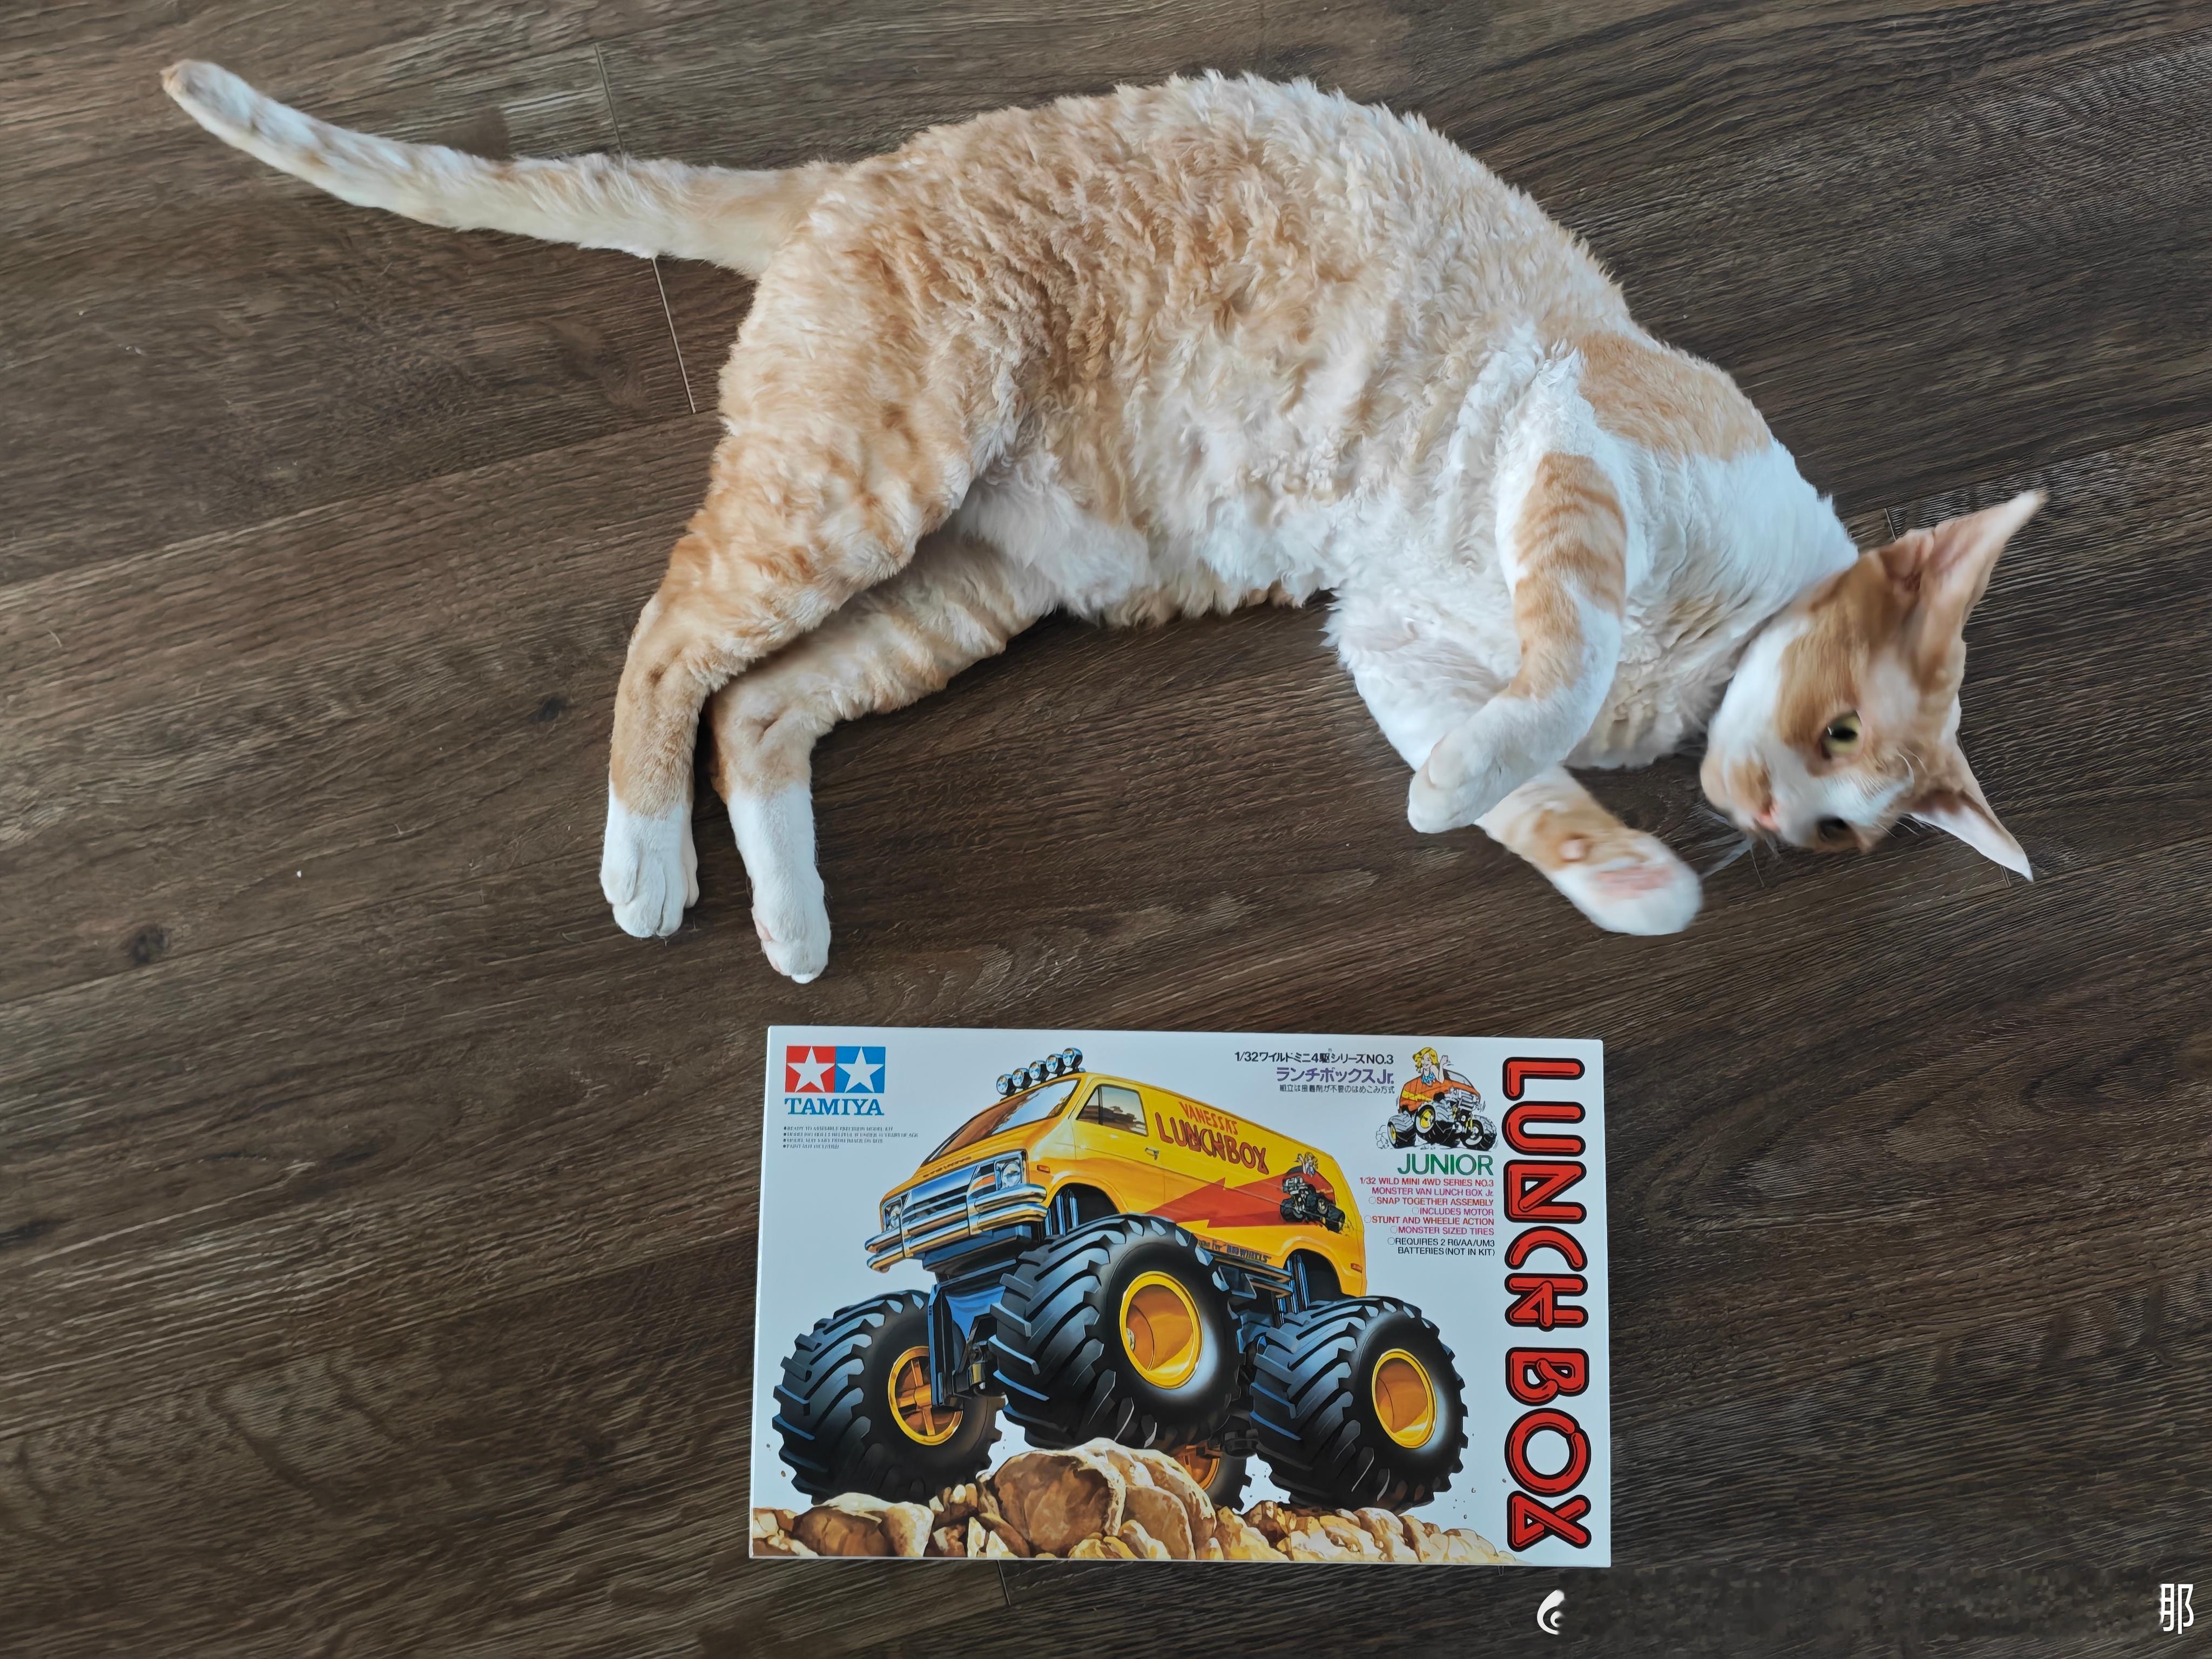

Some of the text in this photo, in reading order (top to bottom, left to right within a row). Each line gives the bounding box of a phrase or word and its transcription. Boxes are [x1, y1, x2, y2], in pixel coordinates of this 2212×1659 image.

[785, 1098, 885, 1116] TAMIYA
[1155, 1111, 1269, 1175] LUNCHBOX
[1397, 1153, 1494, 1176] JUNIOR
[1360, 1177, 1376, 1185] 1/32
[1444, 1178, 1473, 1187] SERIES
[1475, 1179, 1494, 1188] NO.3
[1434, 1188, 1463, 1197] LUNCH
[1377, 1197, 1400, 1205] SNAP
[1402, 1197, 1448, 1205] TOGETHER
[1420, 1208, 1461, 1216] INCLUDES
[1399, 1226, 1494, 1236] MONSTER SIZED TIRES
[1395, 1238, 1438, 1246] REQUIRES
[1479, 1249, 1495, 1257] KIT)
[1502, 1056, 1591, 1553] LUNCH BOX
